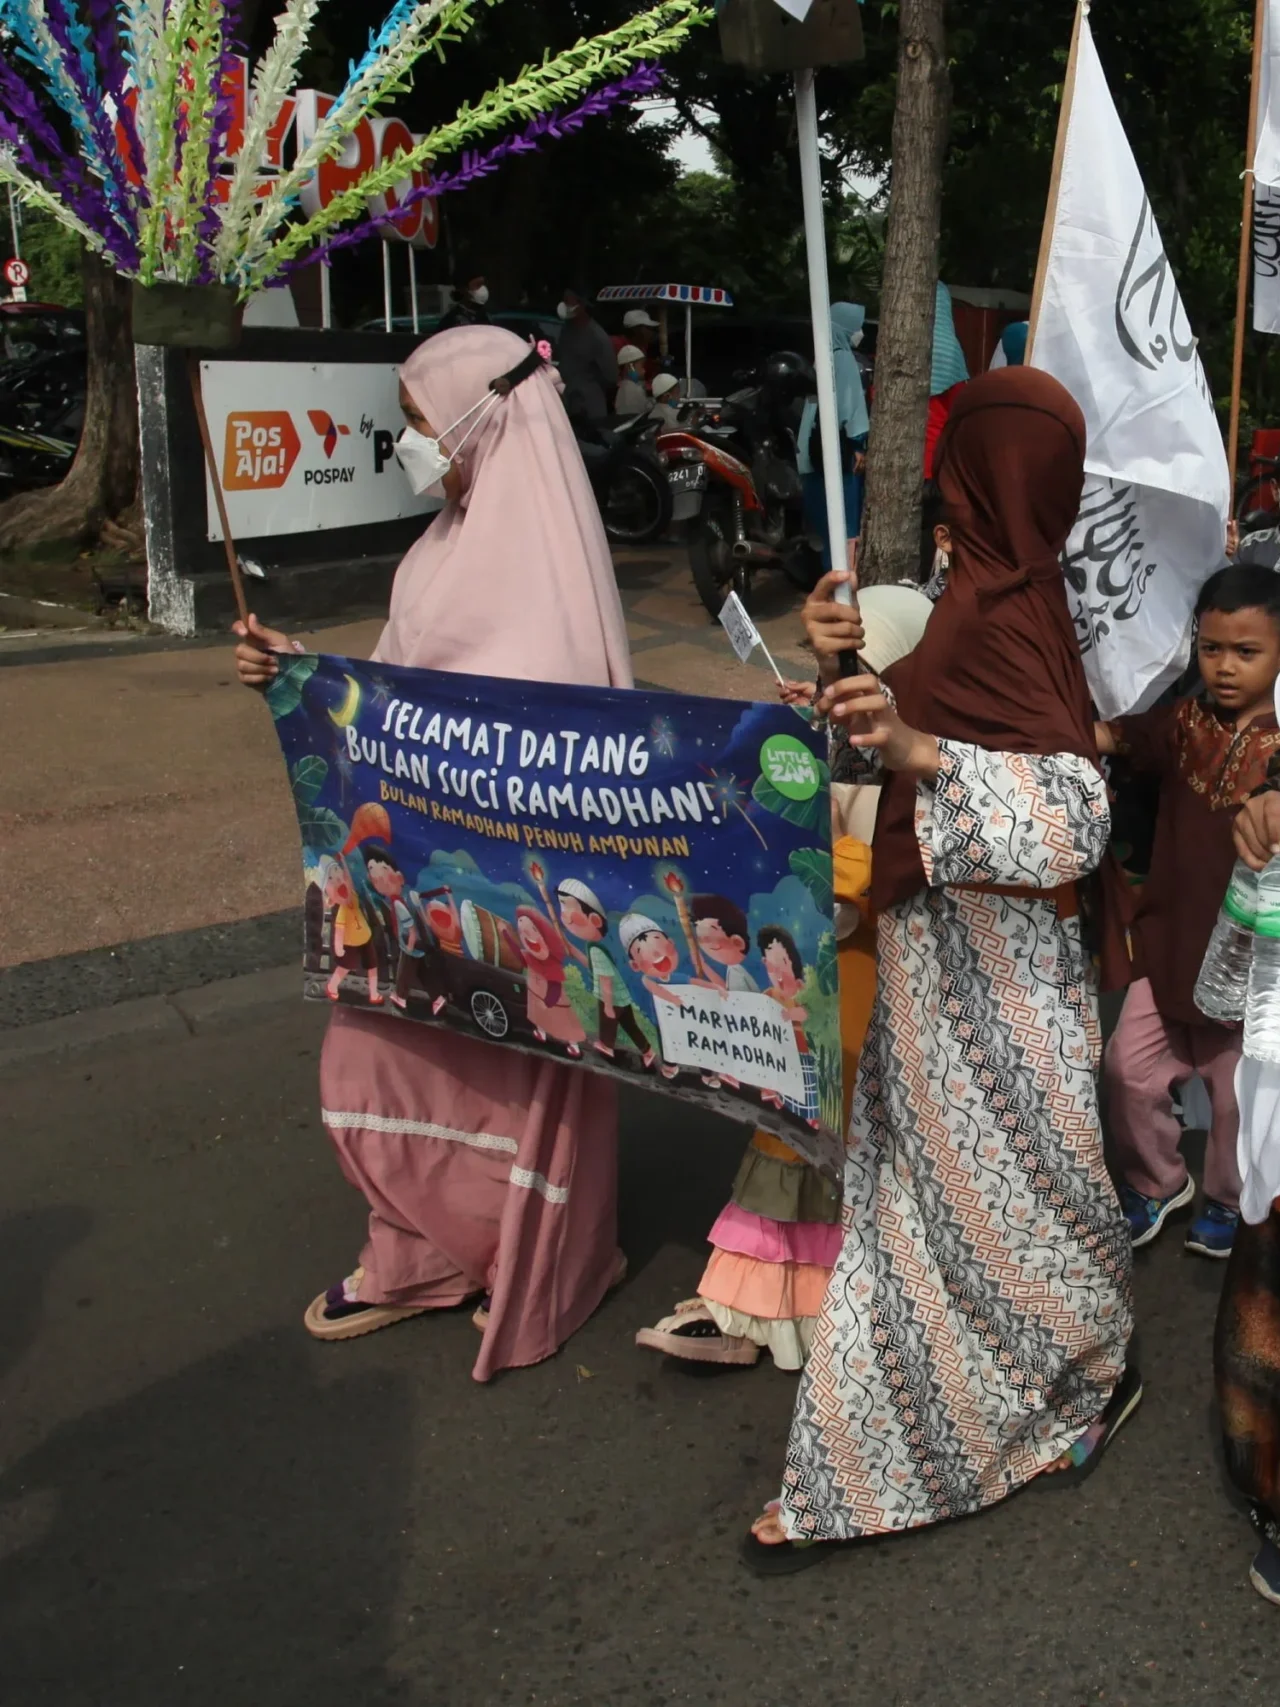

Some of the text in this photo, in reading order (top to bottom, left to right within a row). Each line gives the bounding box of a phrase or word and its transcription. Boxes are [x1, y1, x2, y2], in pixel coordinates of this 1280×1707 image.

[233, 420, 281, 448] Pos
[235, 448, 286, 482] Aja!
[304, 467, 356, 485] POSPAY
[381, 699, 649, 775] SELAMAT DATANG
[766, 747, 811, 765] LITTLE
[768, 761, 816, 784] ZAM
[346, 725, 430, 789] BULAN
[507, 775, 721, 827] RAMADHAN!
[379, 779, 689, 860] BULAN RAMADHAN PENUH AMPUNAN
[680, 1005, 782, 1044] MARHABAN
[687, 1031, 787, 1072] RAMADHAN
